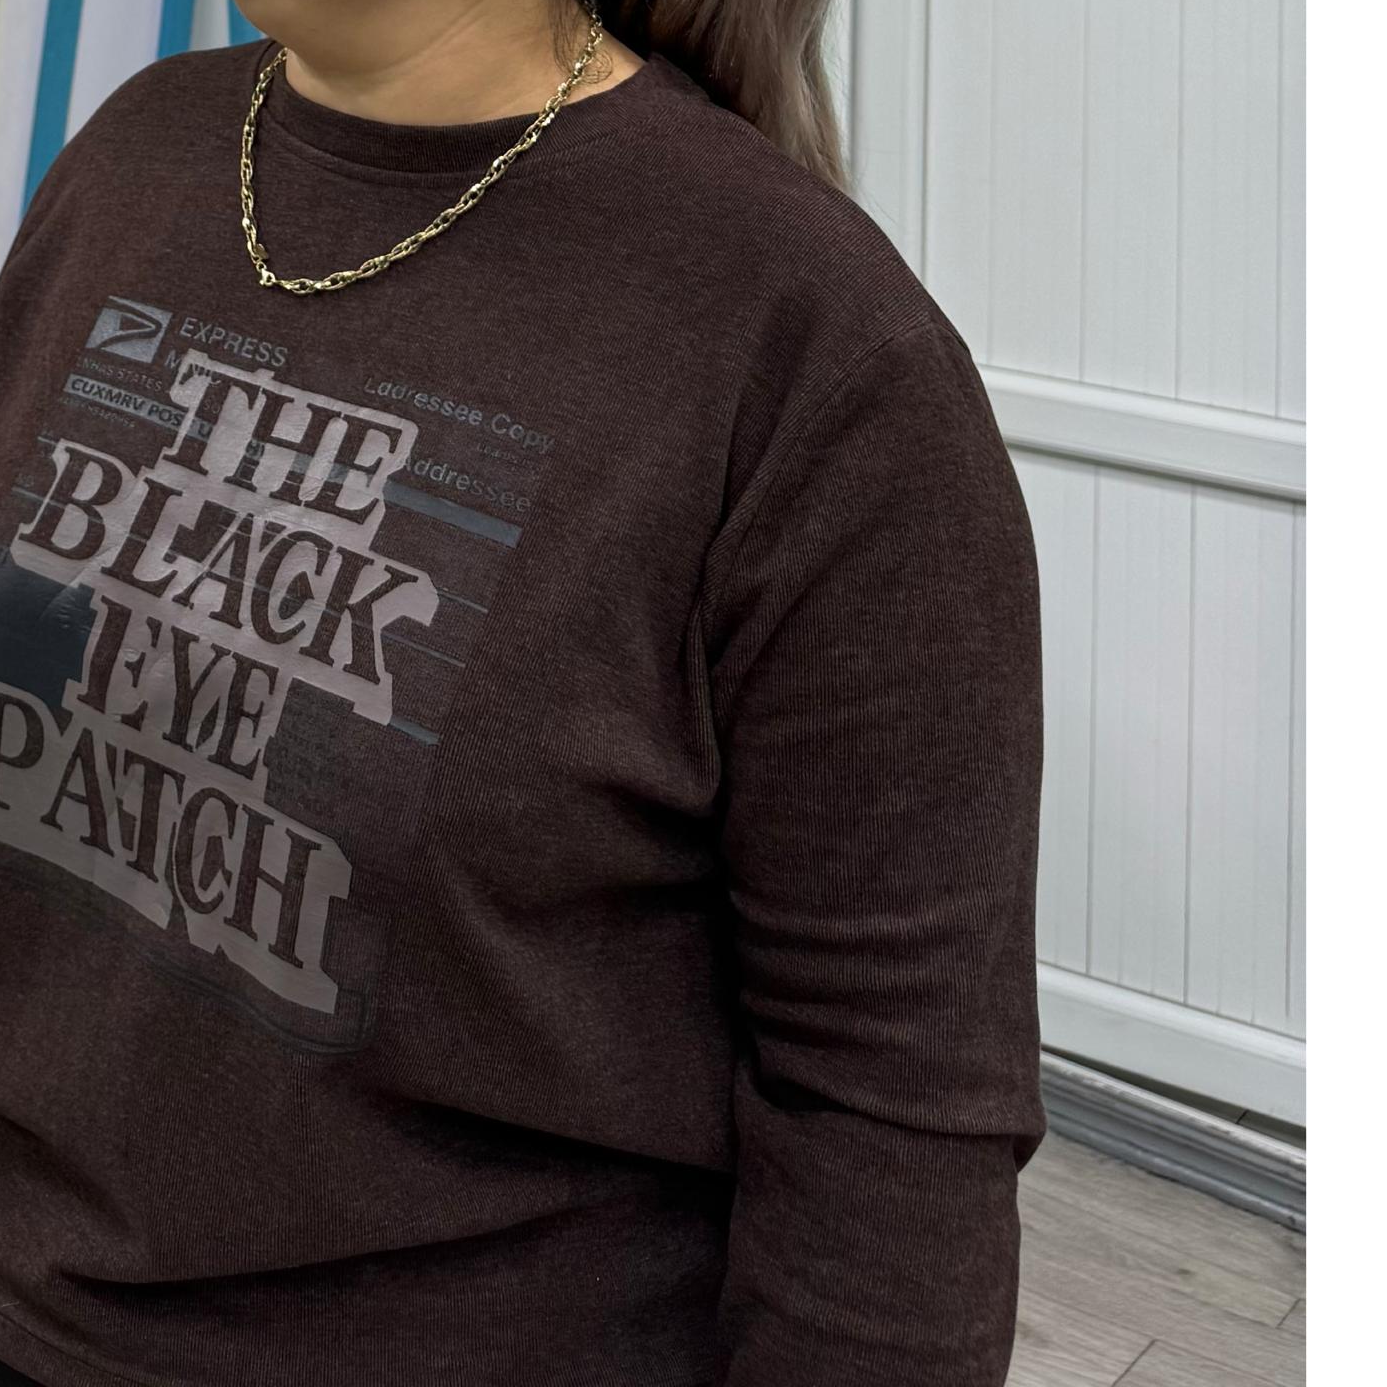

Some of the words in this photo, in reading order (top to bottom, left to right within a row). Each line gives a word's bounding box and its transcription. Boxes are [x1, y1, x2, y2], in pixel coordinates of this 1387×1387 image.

[179, 317, 289, 368] EXPRESS
[164, 365, 406, 527] THE
[490, 413, 556, 455] Copy
[20, 444, 421, 688] BLACK
[77, 594, 281, 781] EYE
